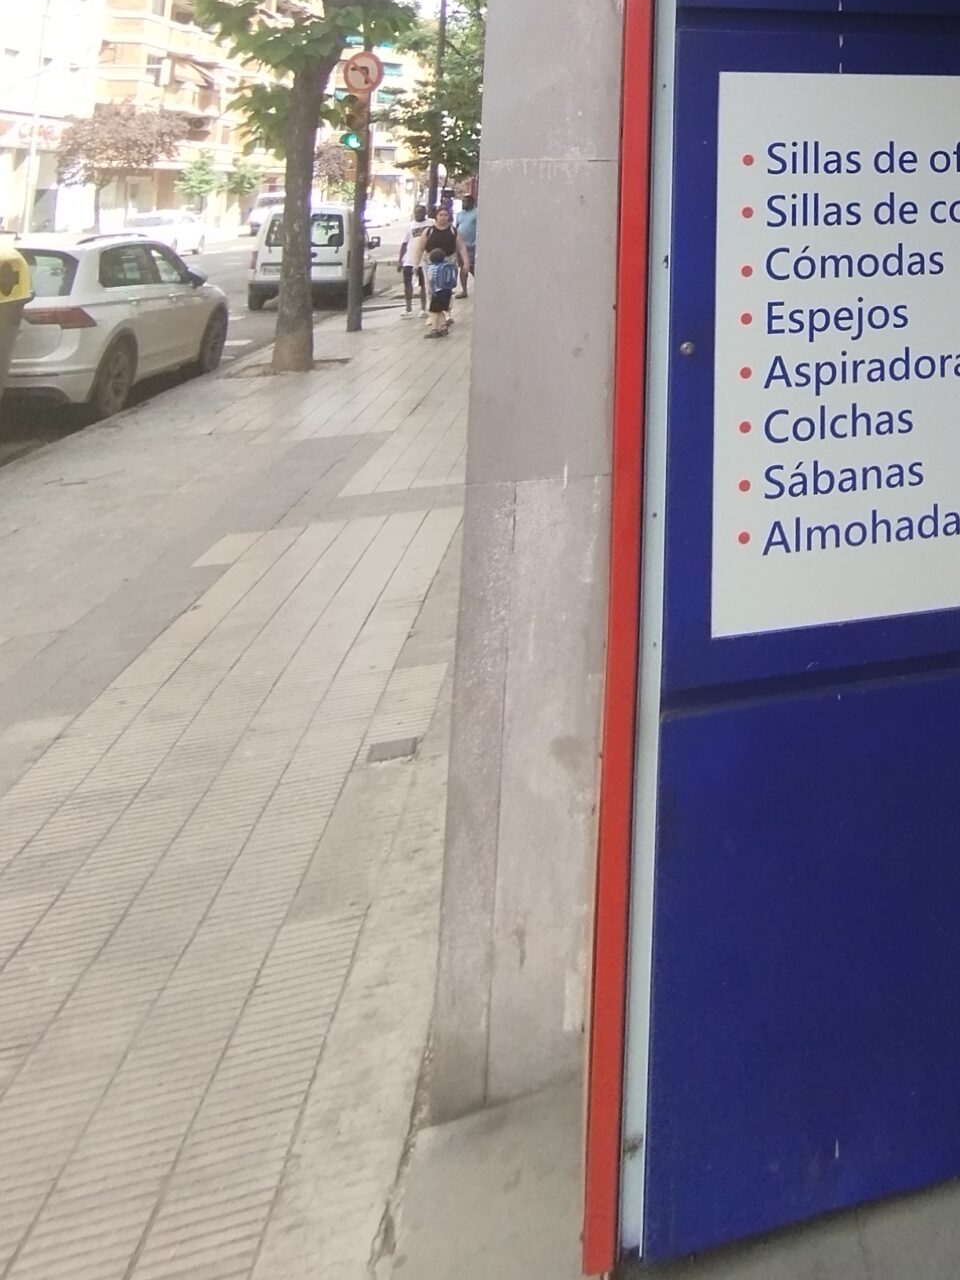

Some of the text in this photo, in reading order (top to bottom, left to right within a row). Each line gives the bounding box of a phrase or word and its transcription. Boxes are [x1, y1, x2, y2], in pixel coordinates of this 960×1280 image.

[767, 140, 862, 175] Sillas
[873, 140, 918, 174] de
[766, 192, 862, 228] Sillas
[873, 191, 919, 226] de
[765, 242, 945, 281] Cómodas
[767, 296, 909, 343] Espejos
[764, 402, 914, 444] Colchas
[764, 459, 924, 500] Sábanas
